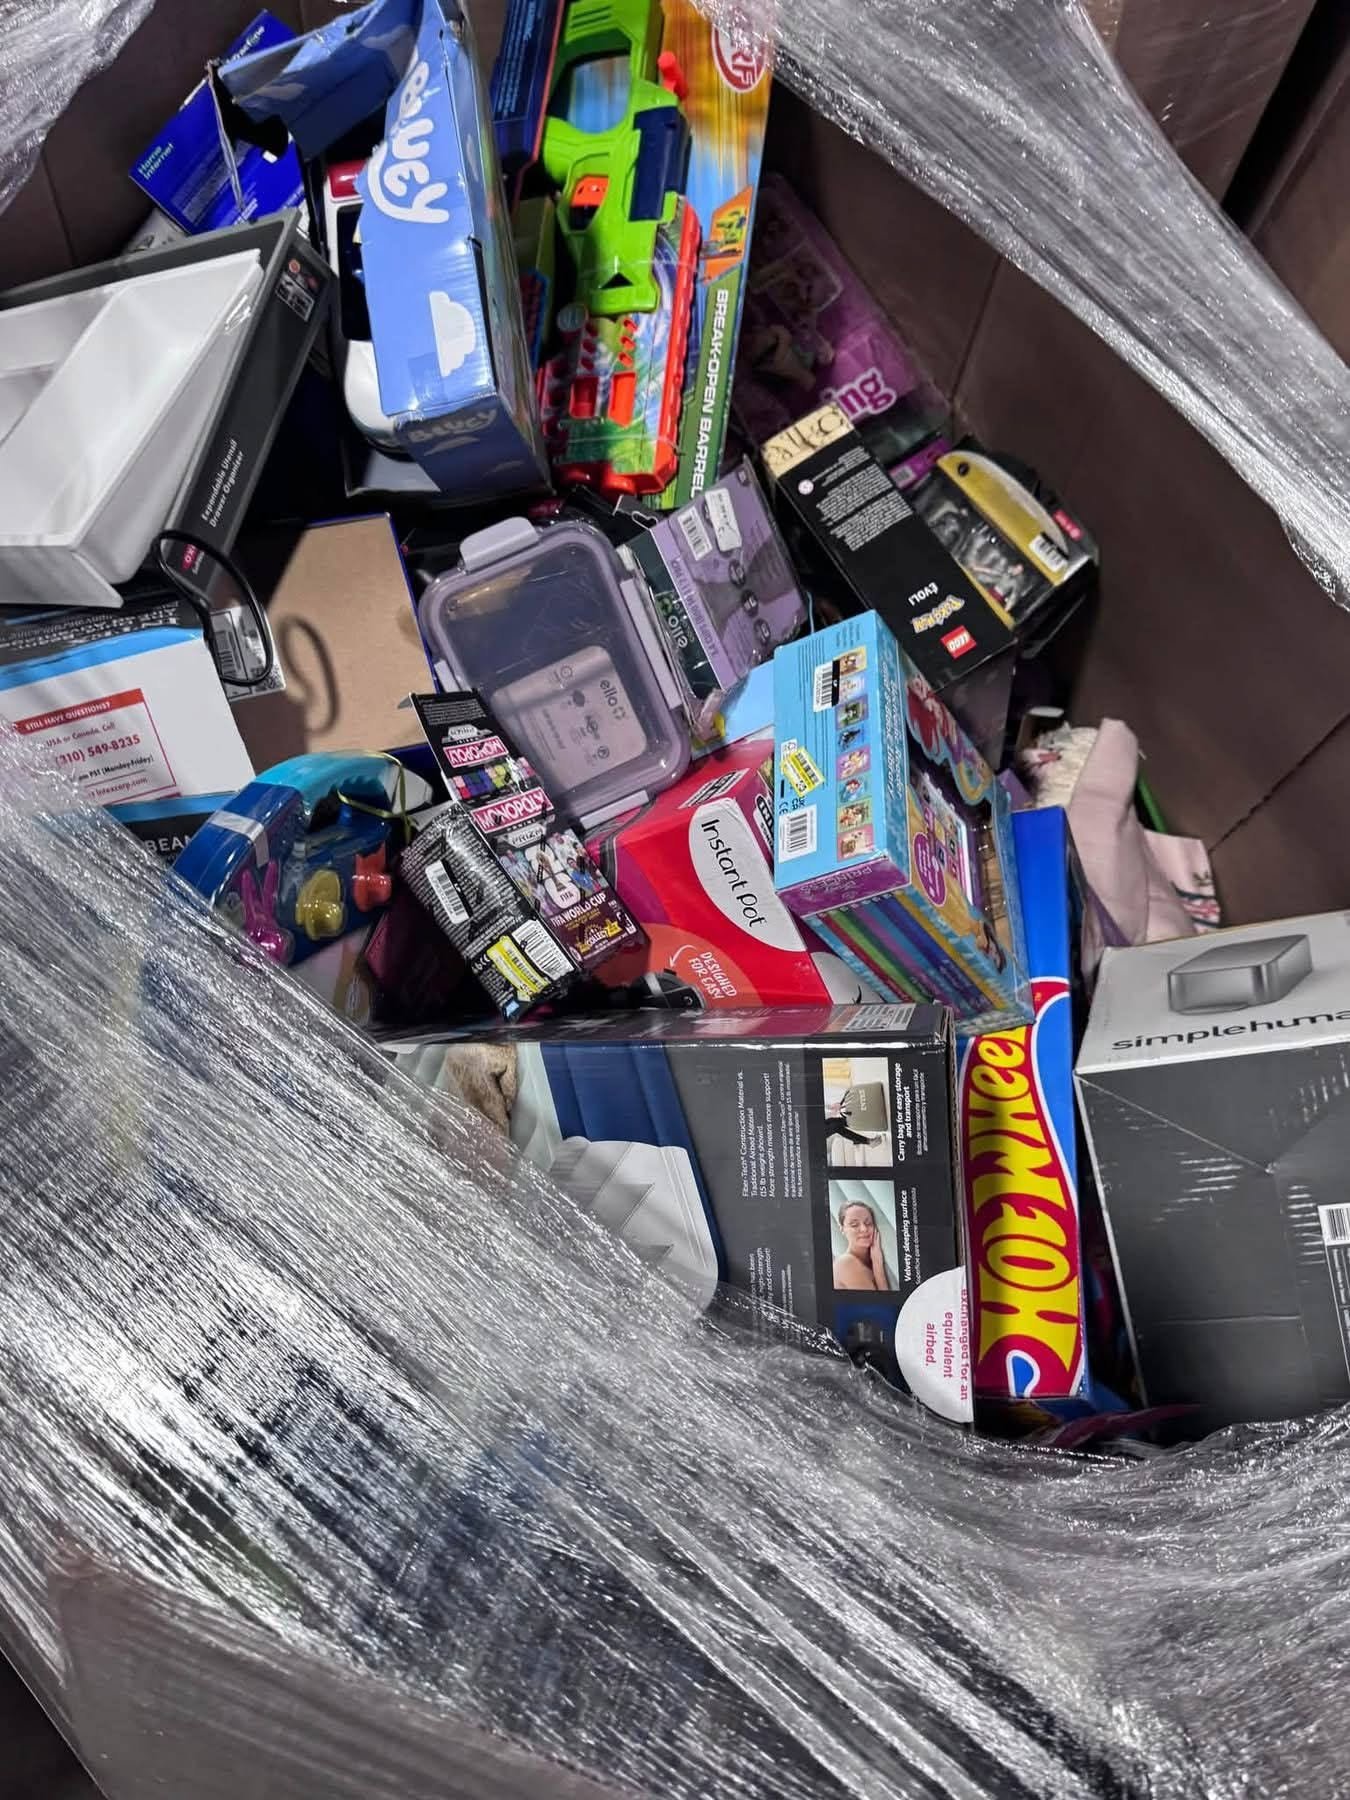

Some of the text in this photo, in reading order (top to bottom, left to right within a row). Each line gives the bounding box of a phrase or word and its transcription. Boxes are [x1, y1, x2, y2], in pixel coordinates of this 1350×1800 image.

[138, 146, 163, 176] Home
[143, 143, 175, 181] Internet
[690, 289, 728, 499] BREAK-OPEN BARREL
[221, 438, 238, 471] Utensil
[209, 494, 227, 528] Drawer
[668, 615, 689, 650] ello
[600, 679, 618, 707] ello
[87, 734, 142, 759] 549-8235
[446, 739, 504, 766] MONOPOLY
[475, 790, 546, 831] MONOPOLY
[702, 819, 748, 892] Instant
[564, 900, 592, 922] WORLD
[589, 891, 608, 907] CUP
[688, 957, 725, 1000] FOR EASY
[700, 951, 737, 998] DESIGNED
[894, 1062, 906, 1162] Carry bag for easy storage
[903, 1086, 913, 1139] and transport
[740, 1110, 748, 1156] Construction
[749, 1161, 758, 1197] Traditional
[767, 1149, 776, 1179] strength
[768, 1180, 776, 1198] More
[900, 1190, 912, 1282] Velvety sleeping surface
[925, 1322, 938, 1367] airbed.
[942, 1311, 956, 1379] equivalent
[960, 1361, 970, 1378] for
[960, 1383, 969, 1400] an
